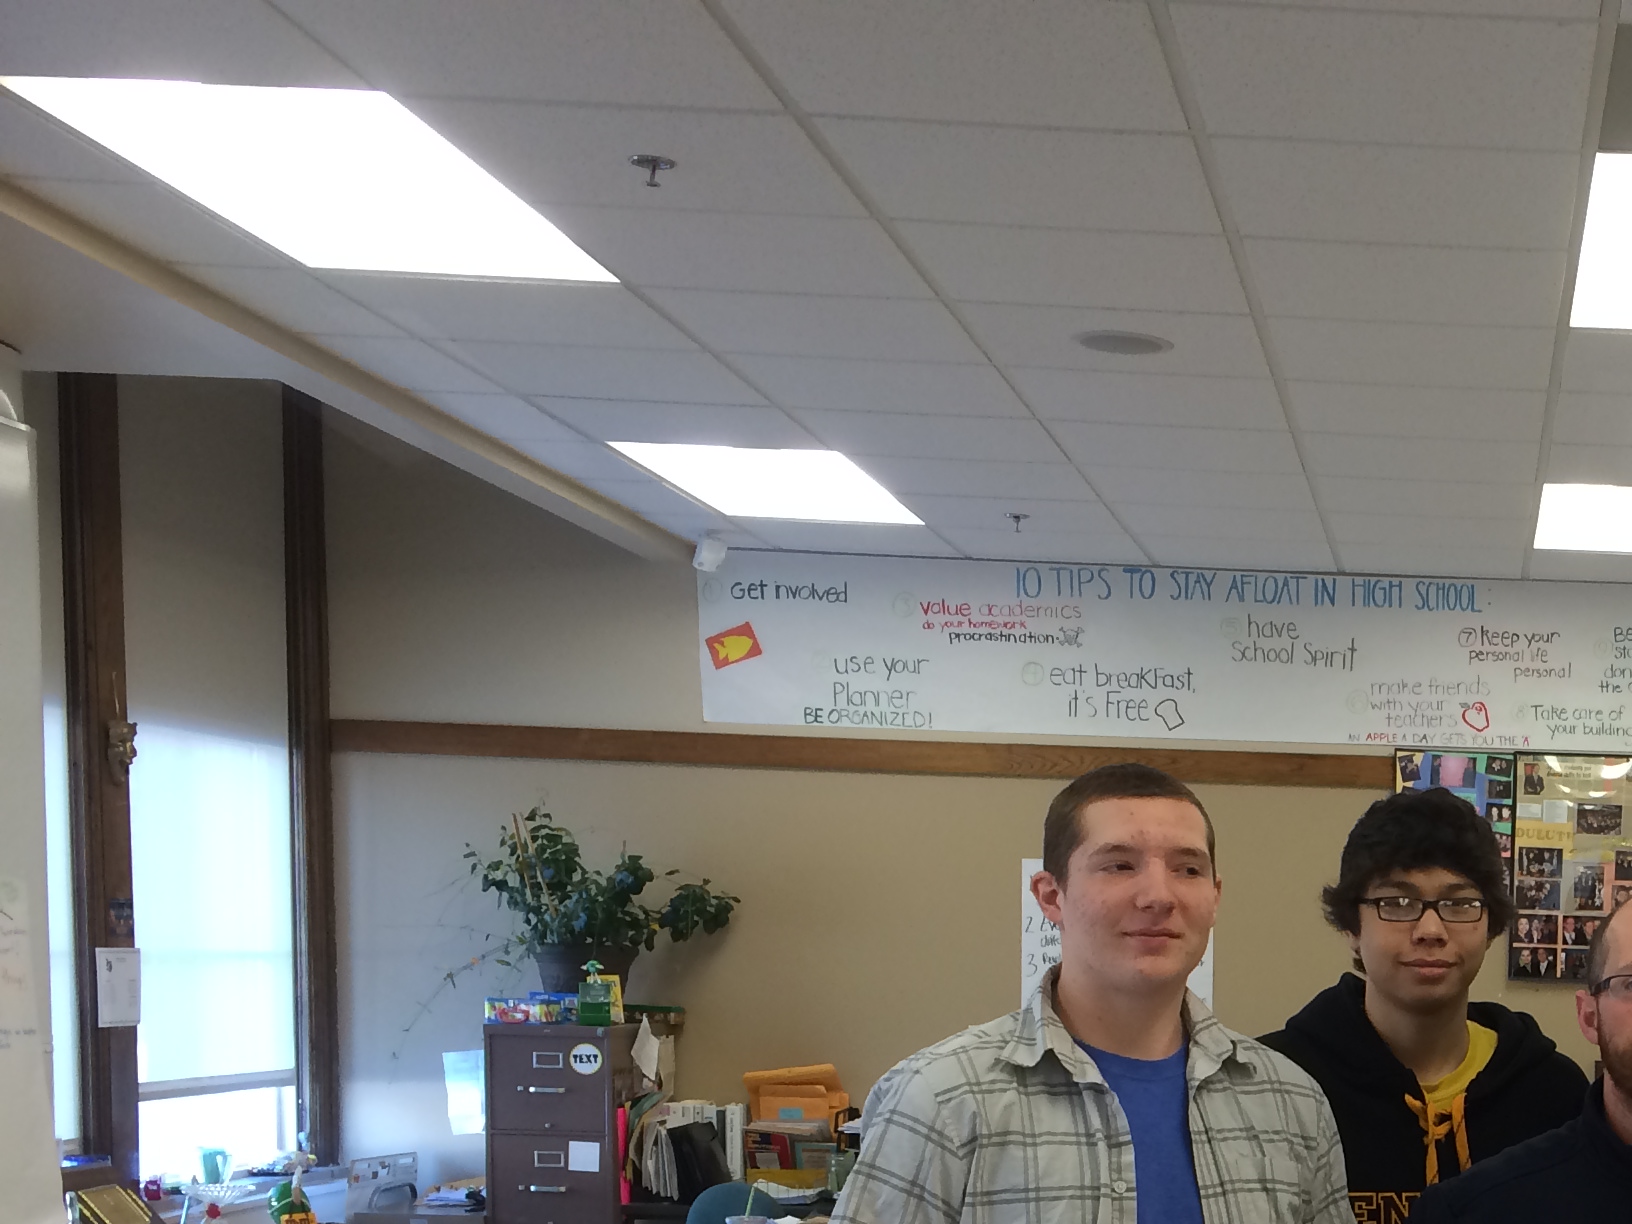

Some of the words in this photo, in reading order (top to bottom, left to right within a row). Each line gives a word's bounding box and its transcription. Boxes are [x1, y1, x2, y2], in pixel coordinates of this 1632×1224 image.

[730, 579, 768, 600] Get
[774, 580, 848, 603] involved
[1015, 567, 1042, 599] 10
[1048, 567, 1112, 600] TIPS
[1122, 568, 1156, 600] TO
[1169, 569, 1218, 601] STAY
[1225, 573, 1308, 607] AFLOAT
[1314, 577, 1337, 607] IN
[1351, 578, 1403, 609] HIGH
[919, 599, 972, 617] value
[978, 600, 1082, 619] academics
[922, 619, 935, 630] do
[939, 620, 966, 634] your
[968, 618, 1028, 630] homework
[1247, 613, 1300, 640] have
[1523, 631, 1561, 649] your
[1231, 641, 1294, 665] School
[1303, 637, 1358, 672] Spirit
[1468, 649, 1524, 665] personal
[834, 656, 875, 675] use
[882, 657, 930, 681] your
[1049, 664, 1087, 687] eat
[1513, 662, 1572, 683] personal
[833, 681, 917, 709] Planner
[1370, 678, 1423, 696] make
[1428, 674, 1491, 697] friends
[1598, 679, 1623, 694] the
[1068, 690, 1098, 718] it's
[1370, 698, 1403, 711] with
[1407, 700, 1445, 718] your
[1530, 704, 1569, 722] Take
[1572, 706, 1604, 722] care
[1608, 704, 1626, 721] of
[803, 707, 824, 724] BE
[827, 708, 933, 729] ORGANIZED!
[1384, 711, 1458, 728] teachers
[1365, 732, 1398, 743] APPLE
[1401, 733, 1408, 743] A
[1412, 733, 1437, 744] DAY
[1440, 733, 1468, 745] GETS
[1470, 734, 1495, 747] YOU
[1496, 735, 1518, 747] THE
[1546, 723, 1579, 740] your
[1515, 827, 1576, 841] DULUTH
[1025, 916, 1035, 933] 2
[1026, 954, 1038, 977] 3
[572, 1054, 599, 1064] TEXT
